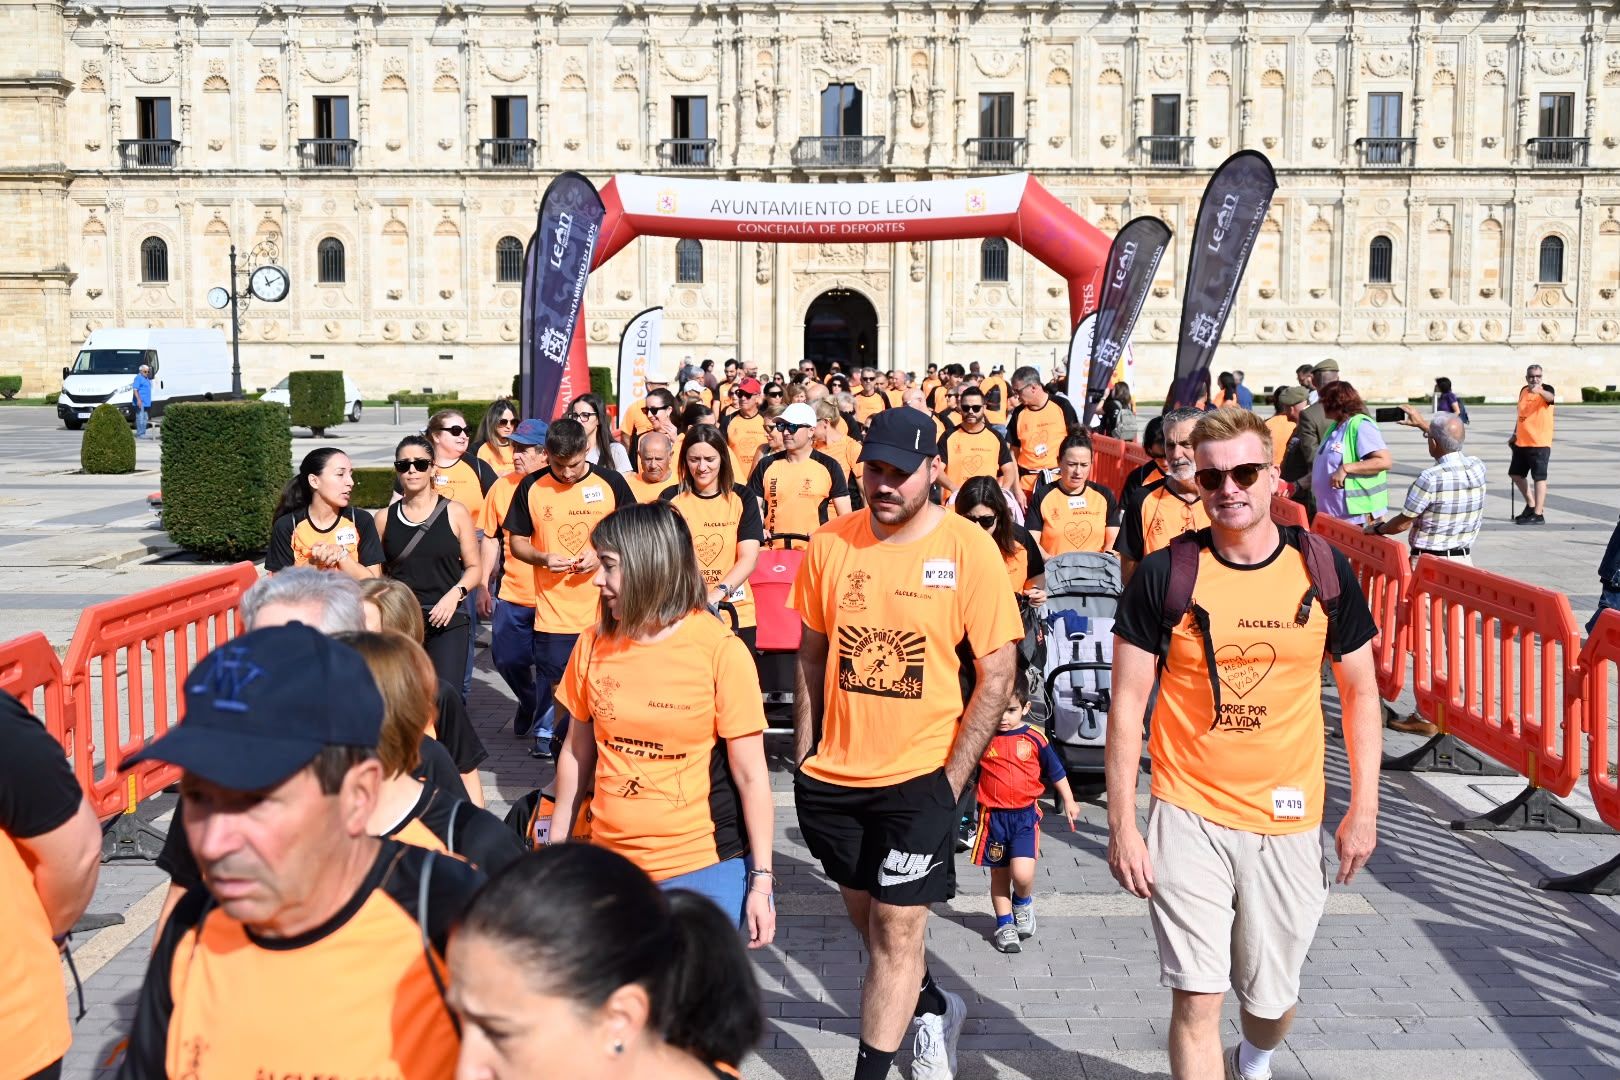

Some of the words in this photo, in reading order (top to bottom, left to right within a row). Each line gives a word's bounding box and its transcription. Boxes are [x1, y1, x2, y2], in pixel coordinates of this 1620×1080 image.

[710, 199, 851, 216] AYUNTAMIENTO
[858, 200, 880, 215] DE
[887, 195, 931, 213] LEÓN
[737, 222, 815, 235] CONCEJALÍA
[820, 223, 836, 234] DE
[841, 222, 905, 234] DEPORTES
[564, 264, 587, 334] AYUNTAMIENTO
[1083, 283, 1095, 314] RTES
[938, 570, 954, 579] 228
[853, 634, 873, 657] CORRE
[873, 631, 887, 642] POR
[886, 634, 896, 646] LA
[893, 641, 906, 662] VIDA
[1235, 672, 1260, 690] VIDA
[1214, 703, 1246, 715] ORRE
[1248, 705, 1267, 716] POR
[1220, 714, 1233, 727] LA
[614, 736, 664, 752] CORRE
[1286, 799, 1302, 809] 479
[883, 848, 933, 875] RUN
